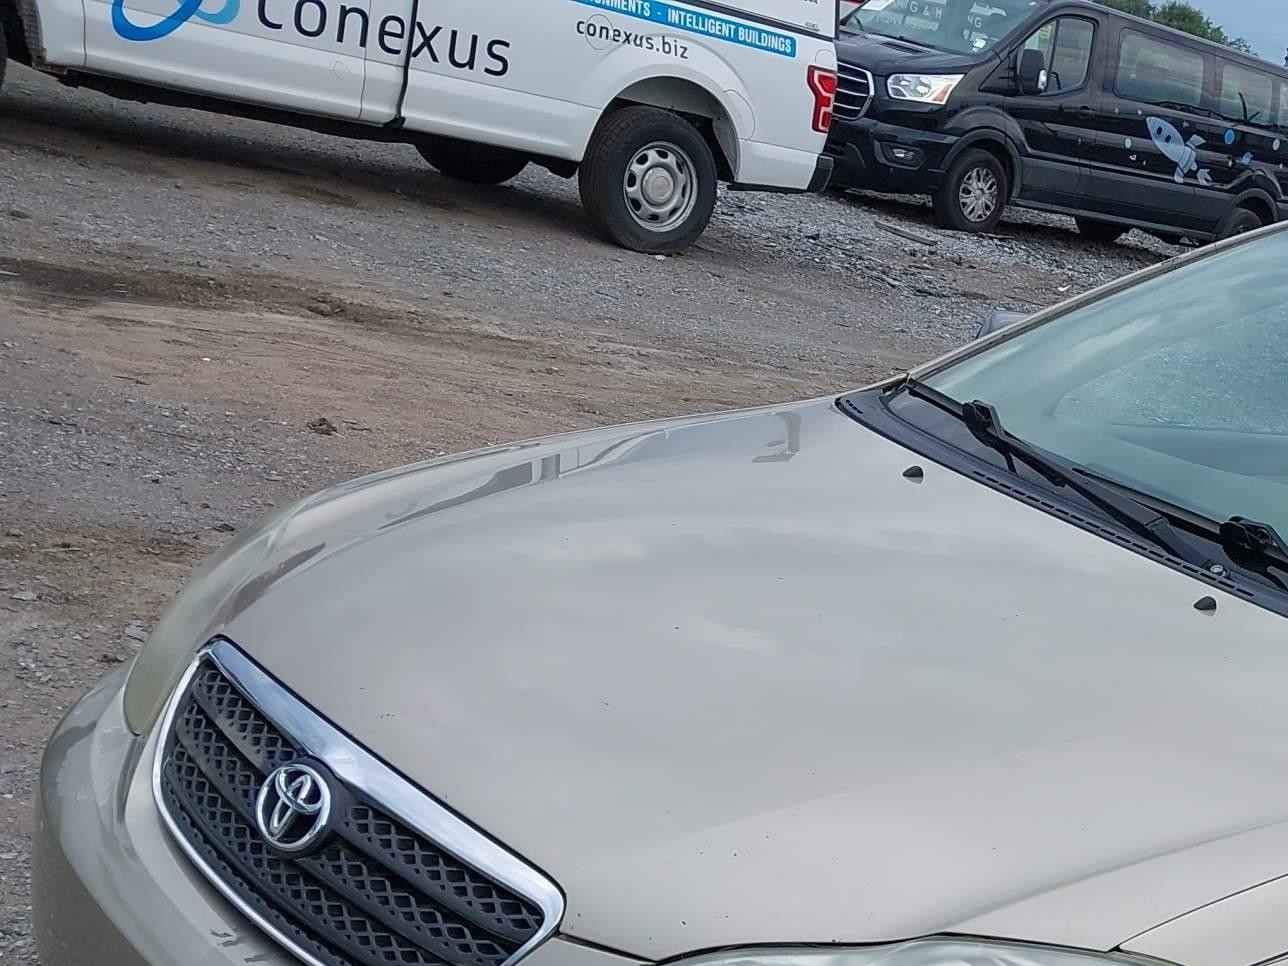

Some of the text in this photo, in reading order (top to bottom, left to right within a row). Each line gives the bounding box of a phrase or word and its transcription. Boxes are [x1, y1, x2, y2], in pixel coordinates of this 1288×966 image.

[257, 0, 511, 77] conexus
[576, 20, 689, 60] conexus.biz
[667, 8, 736, 39] INTELLIGENT
[737, 27, 792, 53] BUILDINGS
